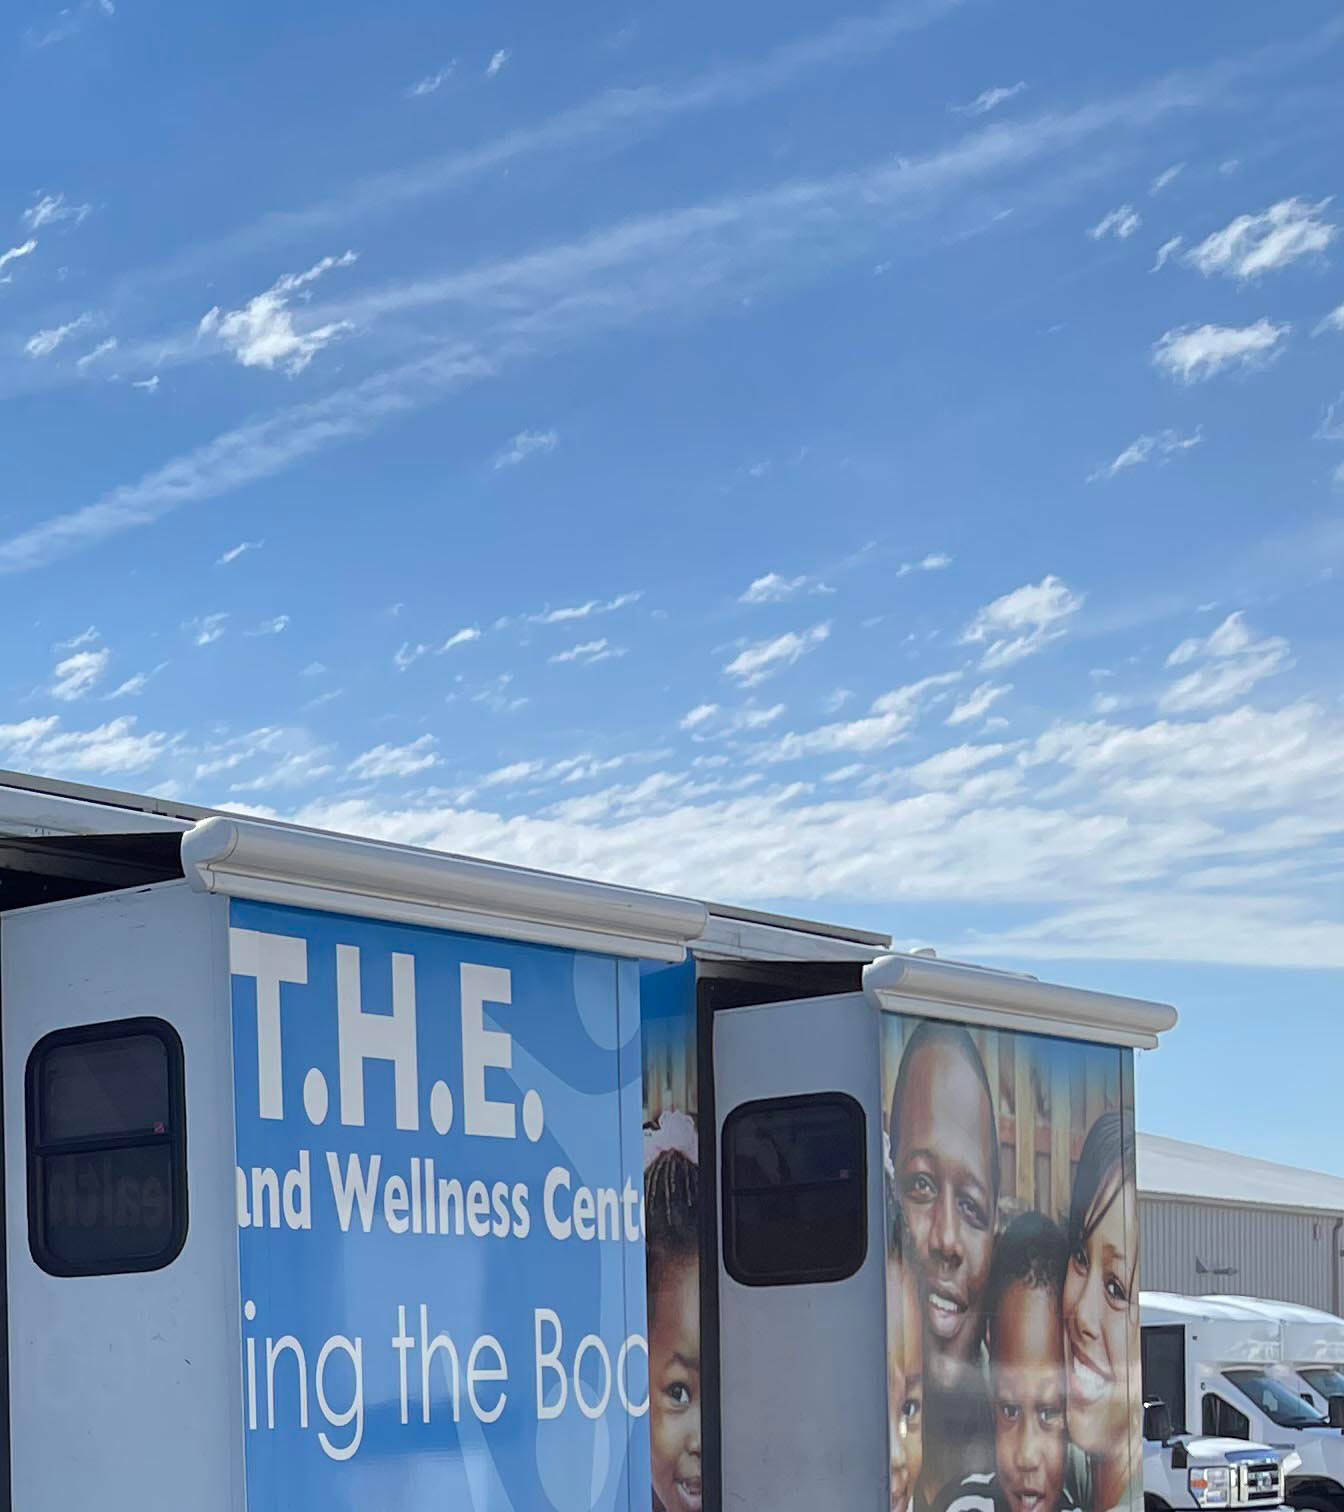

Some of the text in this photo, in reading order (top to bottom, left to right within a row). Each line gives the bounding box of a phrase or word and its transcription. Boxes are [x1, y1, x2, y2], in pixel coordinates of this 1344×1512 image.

[229, 927, 544, 1142] T.H.E.
[326, 1151, 530, 1240] Wellness
[543, 1166, 647, 1242] Cent
[244, 1300, 365, 1461] ing
[392, 1304, 509, 1425] the
